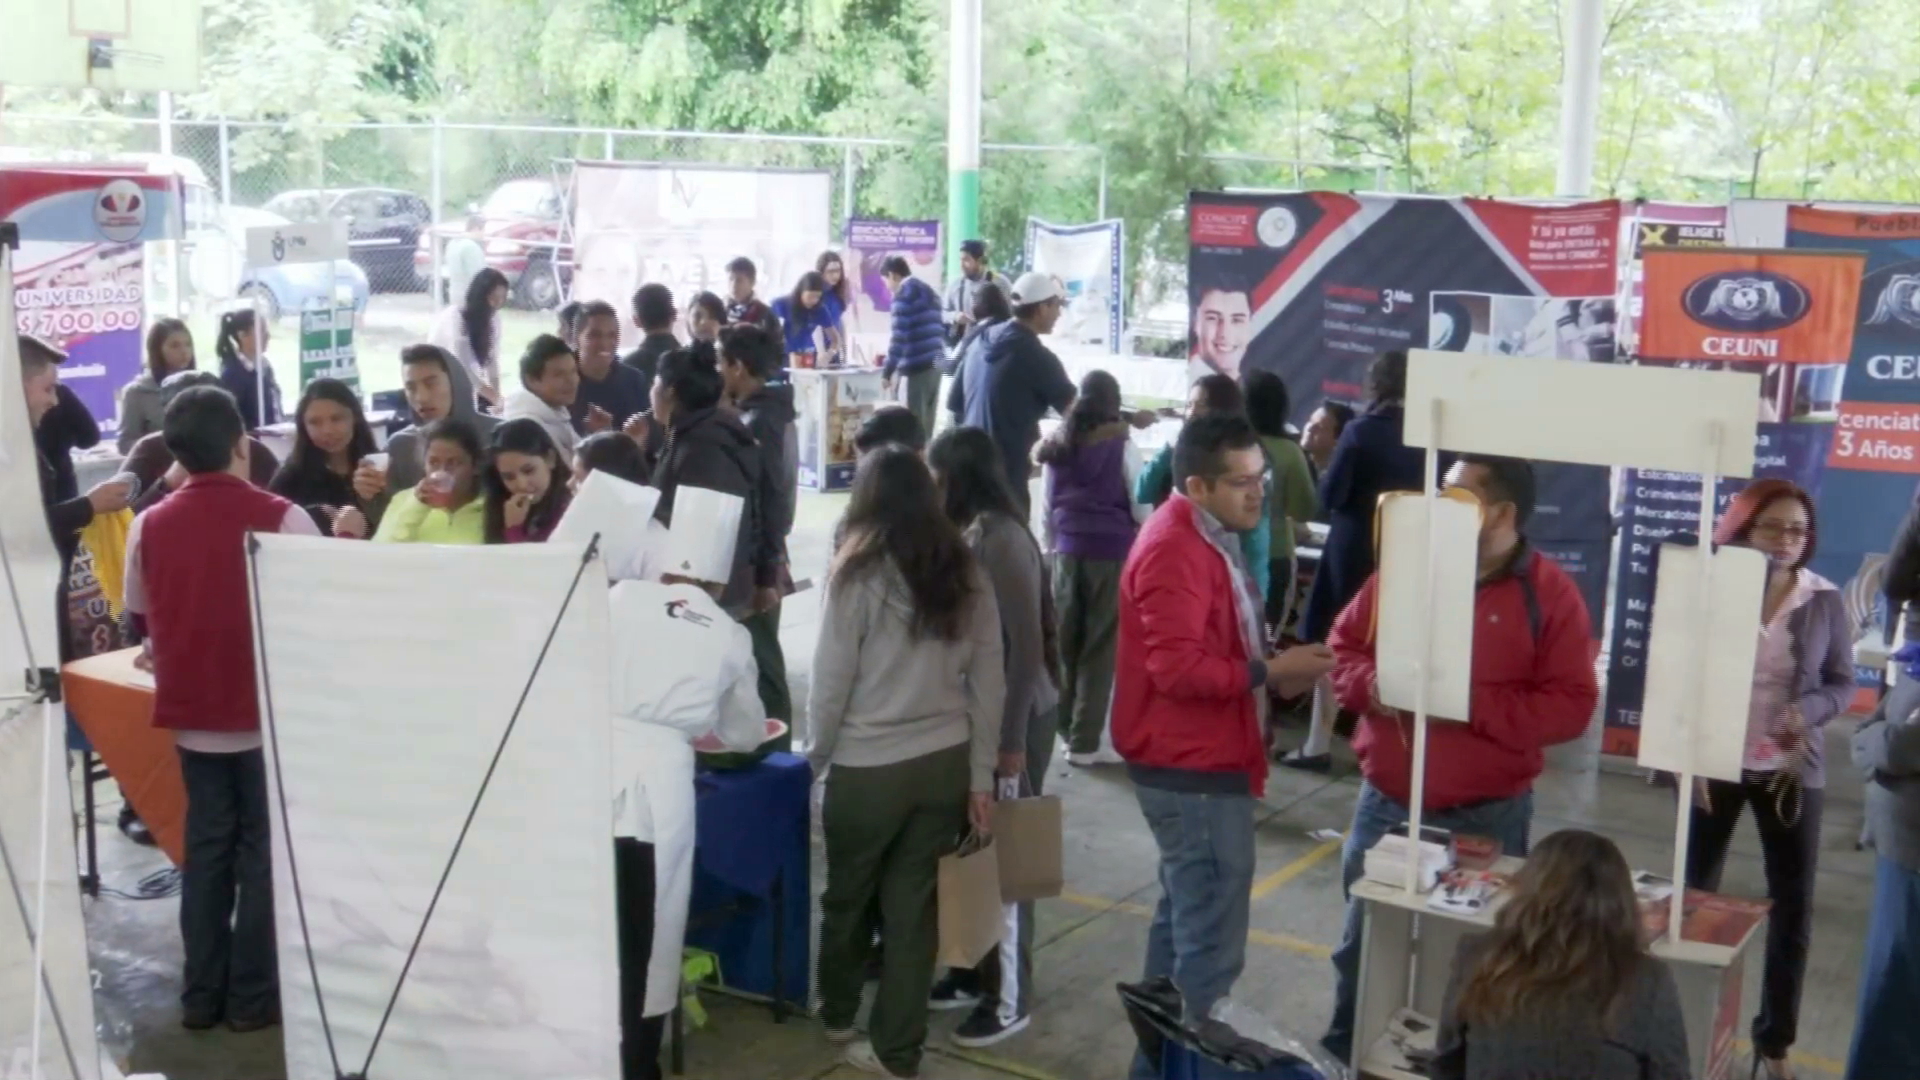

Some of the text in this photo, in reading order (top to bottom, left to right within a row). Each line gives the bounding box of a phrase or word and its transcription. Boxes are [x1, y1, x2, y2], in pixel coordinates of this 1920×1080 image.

[1855, 215, 1920, 232] Puebl
[19, 286, 140, 306] UNIVERSIDAD
[1381, 288, 1394, 314] 3
[1702, 336, 1778, 357] CEUNI
[1866, 354, 1920, 380] CE
[1838, 410, 1920, 432] cenciat
[1836, 430, 1914, 460] 3 Años
